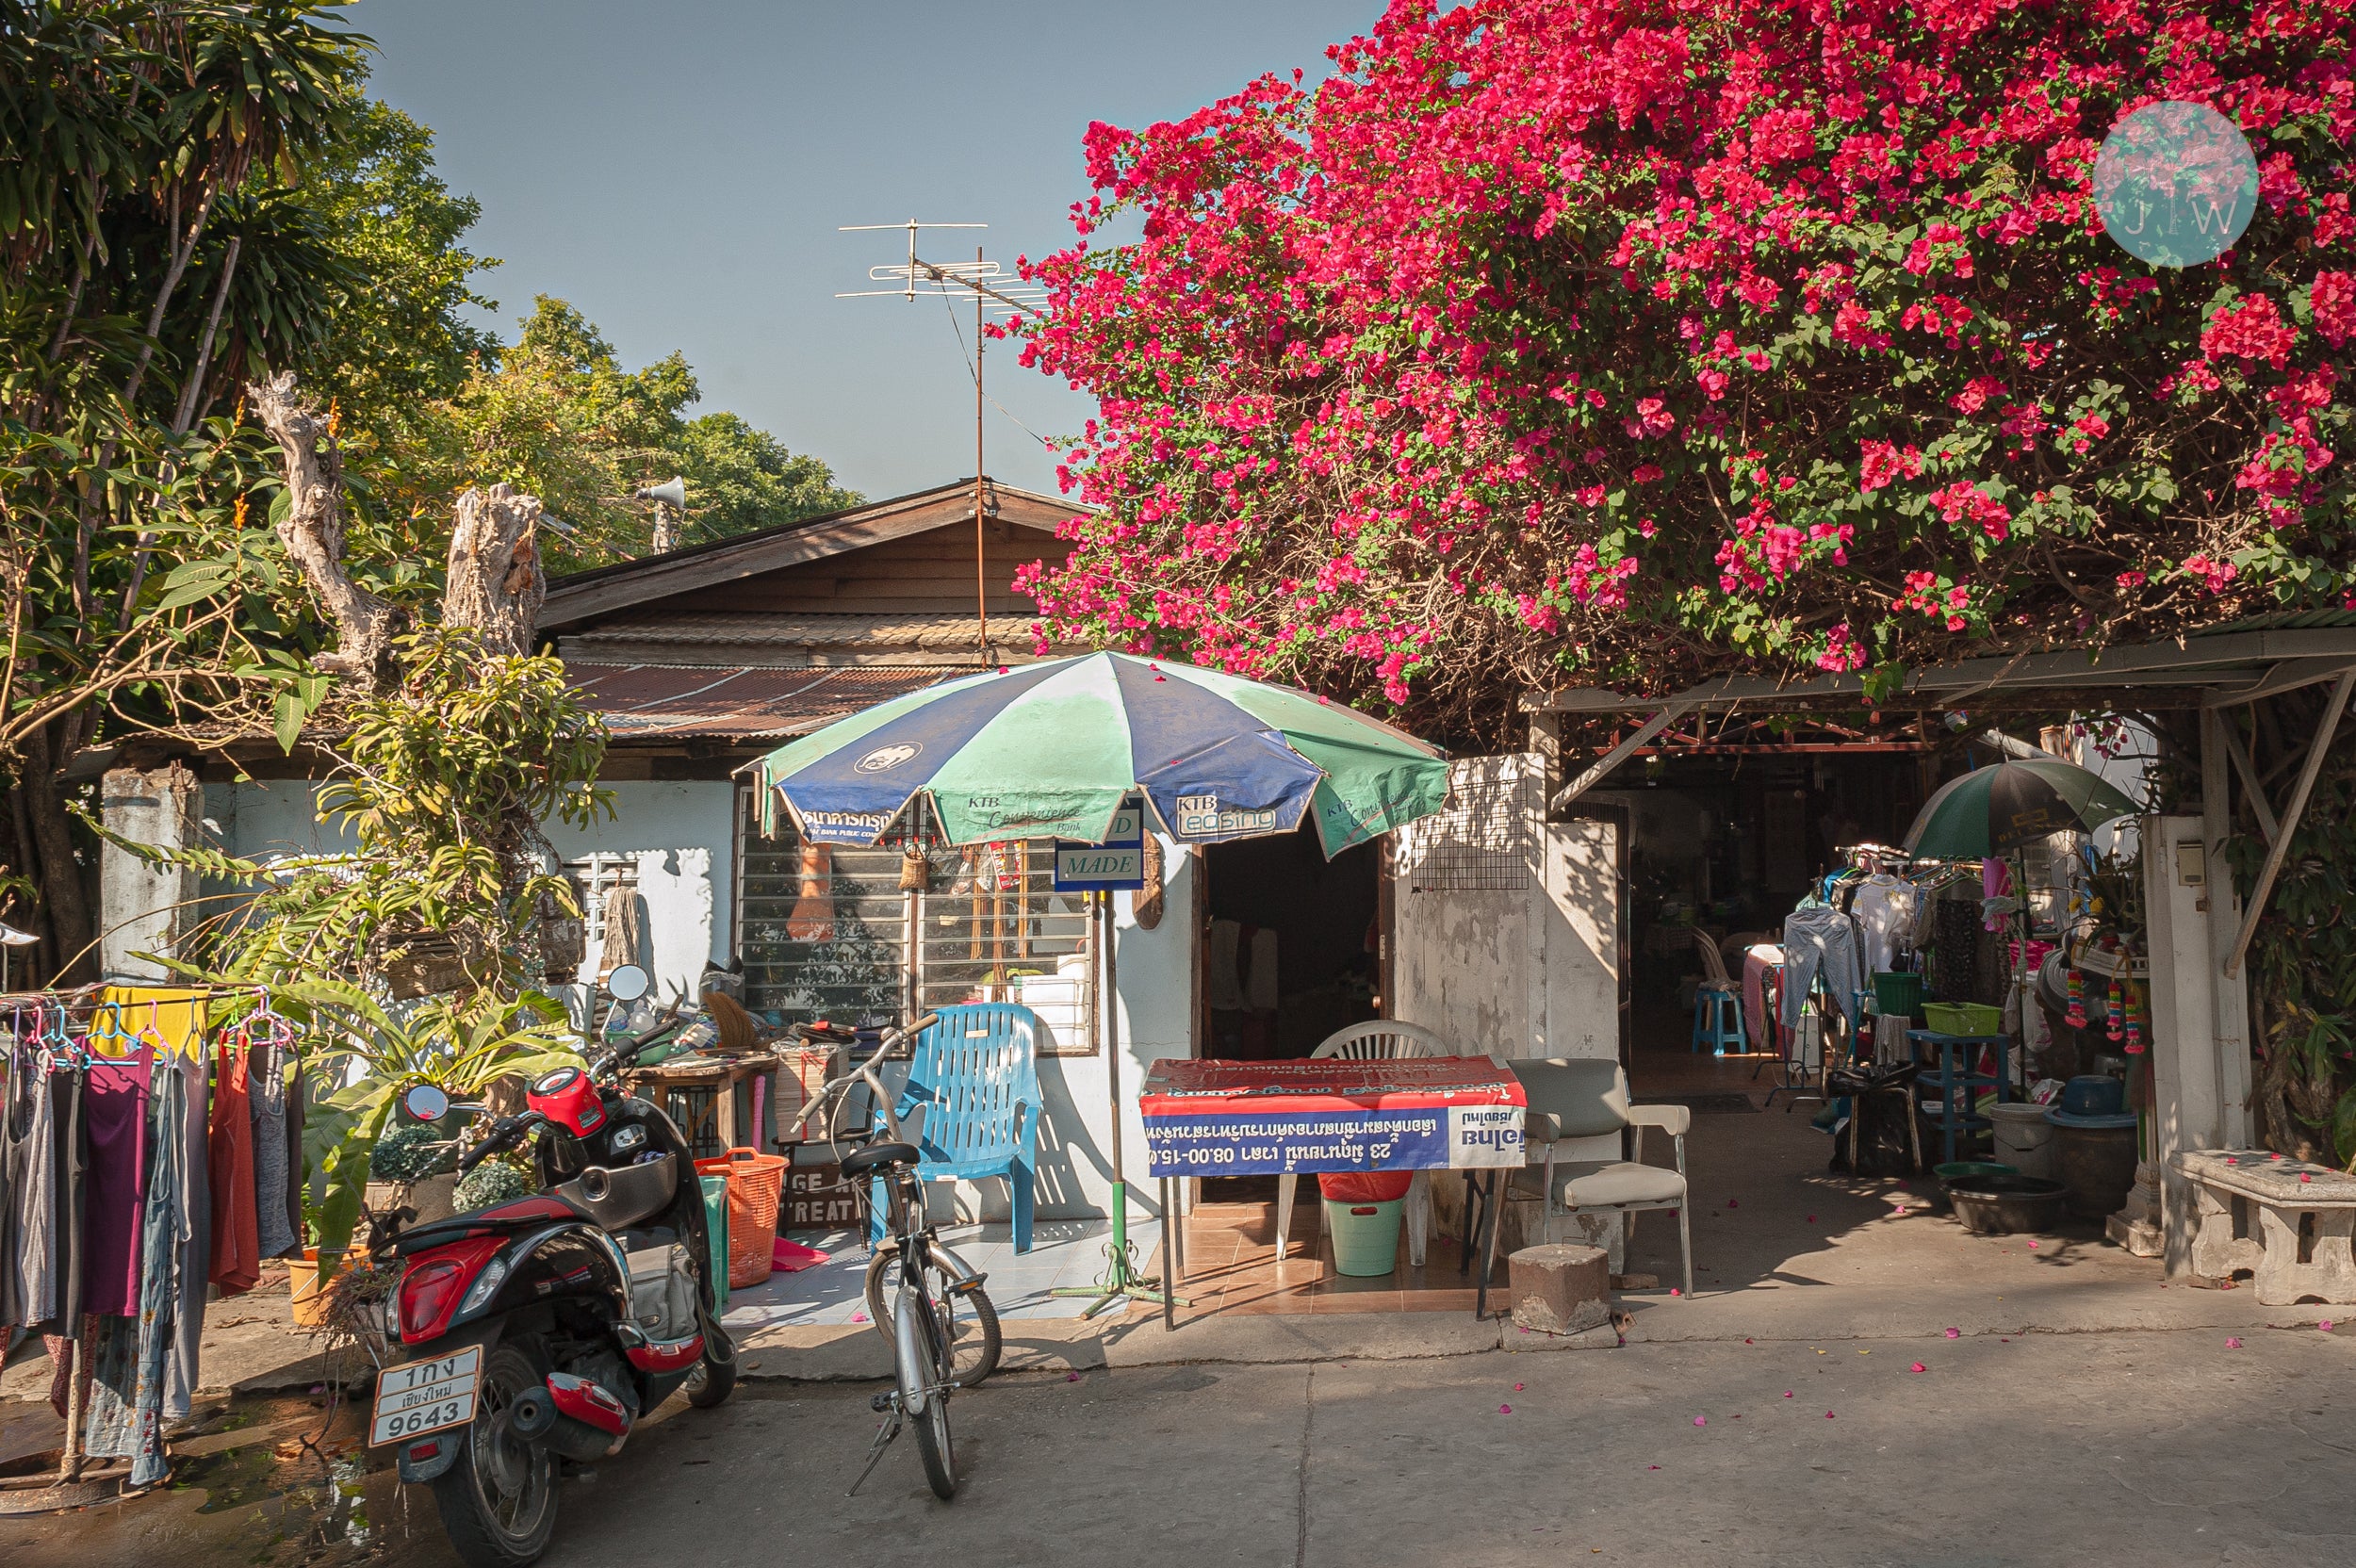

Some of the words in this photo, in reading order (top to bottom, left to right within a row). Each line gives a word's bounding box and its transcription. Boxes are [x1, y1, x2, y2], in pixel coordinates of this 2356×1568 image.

[969, 796, 1000, 808] KTB
[1178, 796, 1216, 811] KTB
[1327, 799, 1353, 818] KTB
[989, 808, 1082, 829] Convenience
[1064, 856, 1134, 874] MADE
[1462, 1113, 1512, 1126] เชียงใหม่
[1241, 1146, 1279, 1161] เวลา
[1284, 1138, 1365, 1171] มิถุนายนนี้
[1369, 1143, 1391, 1159] 23
[405, 1358, 456, 1388] 1กง
[401, 1382, 452, 1409] เชียงใหม่
[387, 1401, 459, 1437] 9643
